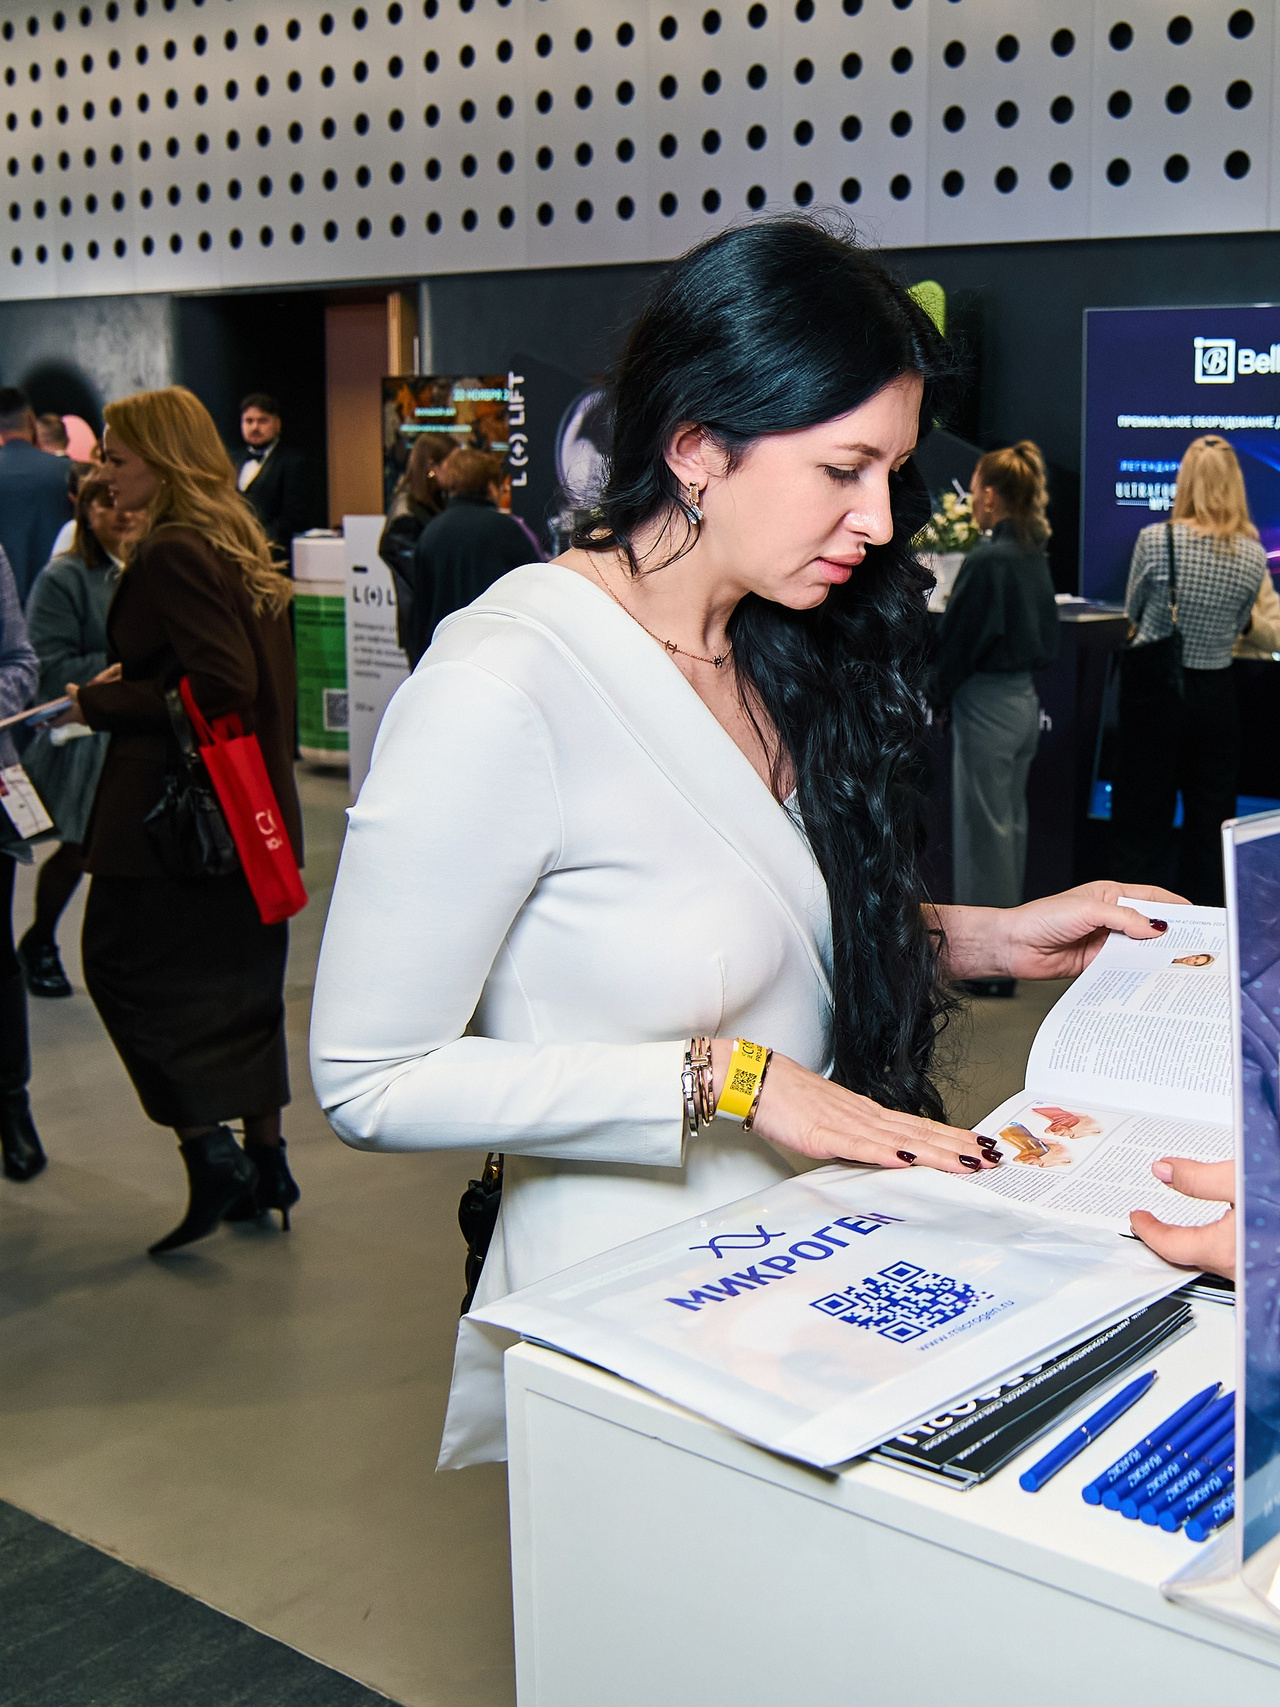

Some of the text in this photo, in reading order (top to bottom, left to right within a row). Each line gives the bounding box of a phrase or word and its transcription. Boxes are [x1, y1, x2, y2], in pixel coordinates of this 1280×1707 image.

[508, 370, 526, 426] LIFT
[666, 1212, 906, 1311] МИКРОГЕН
[916, 1299, 1016, 1352] www.microgen.ru
